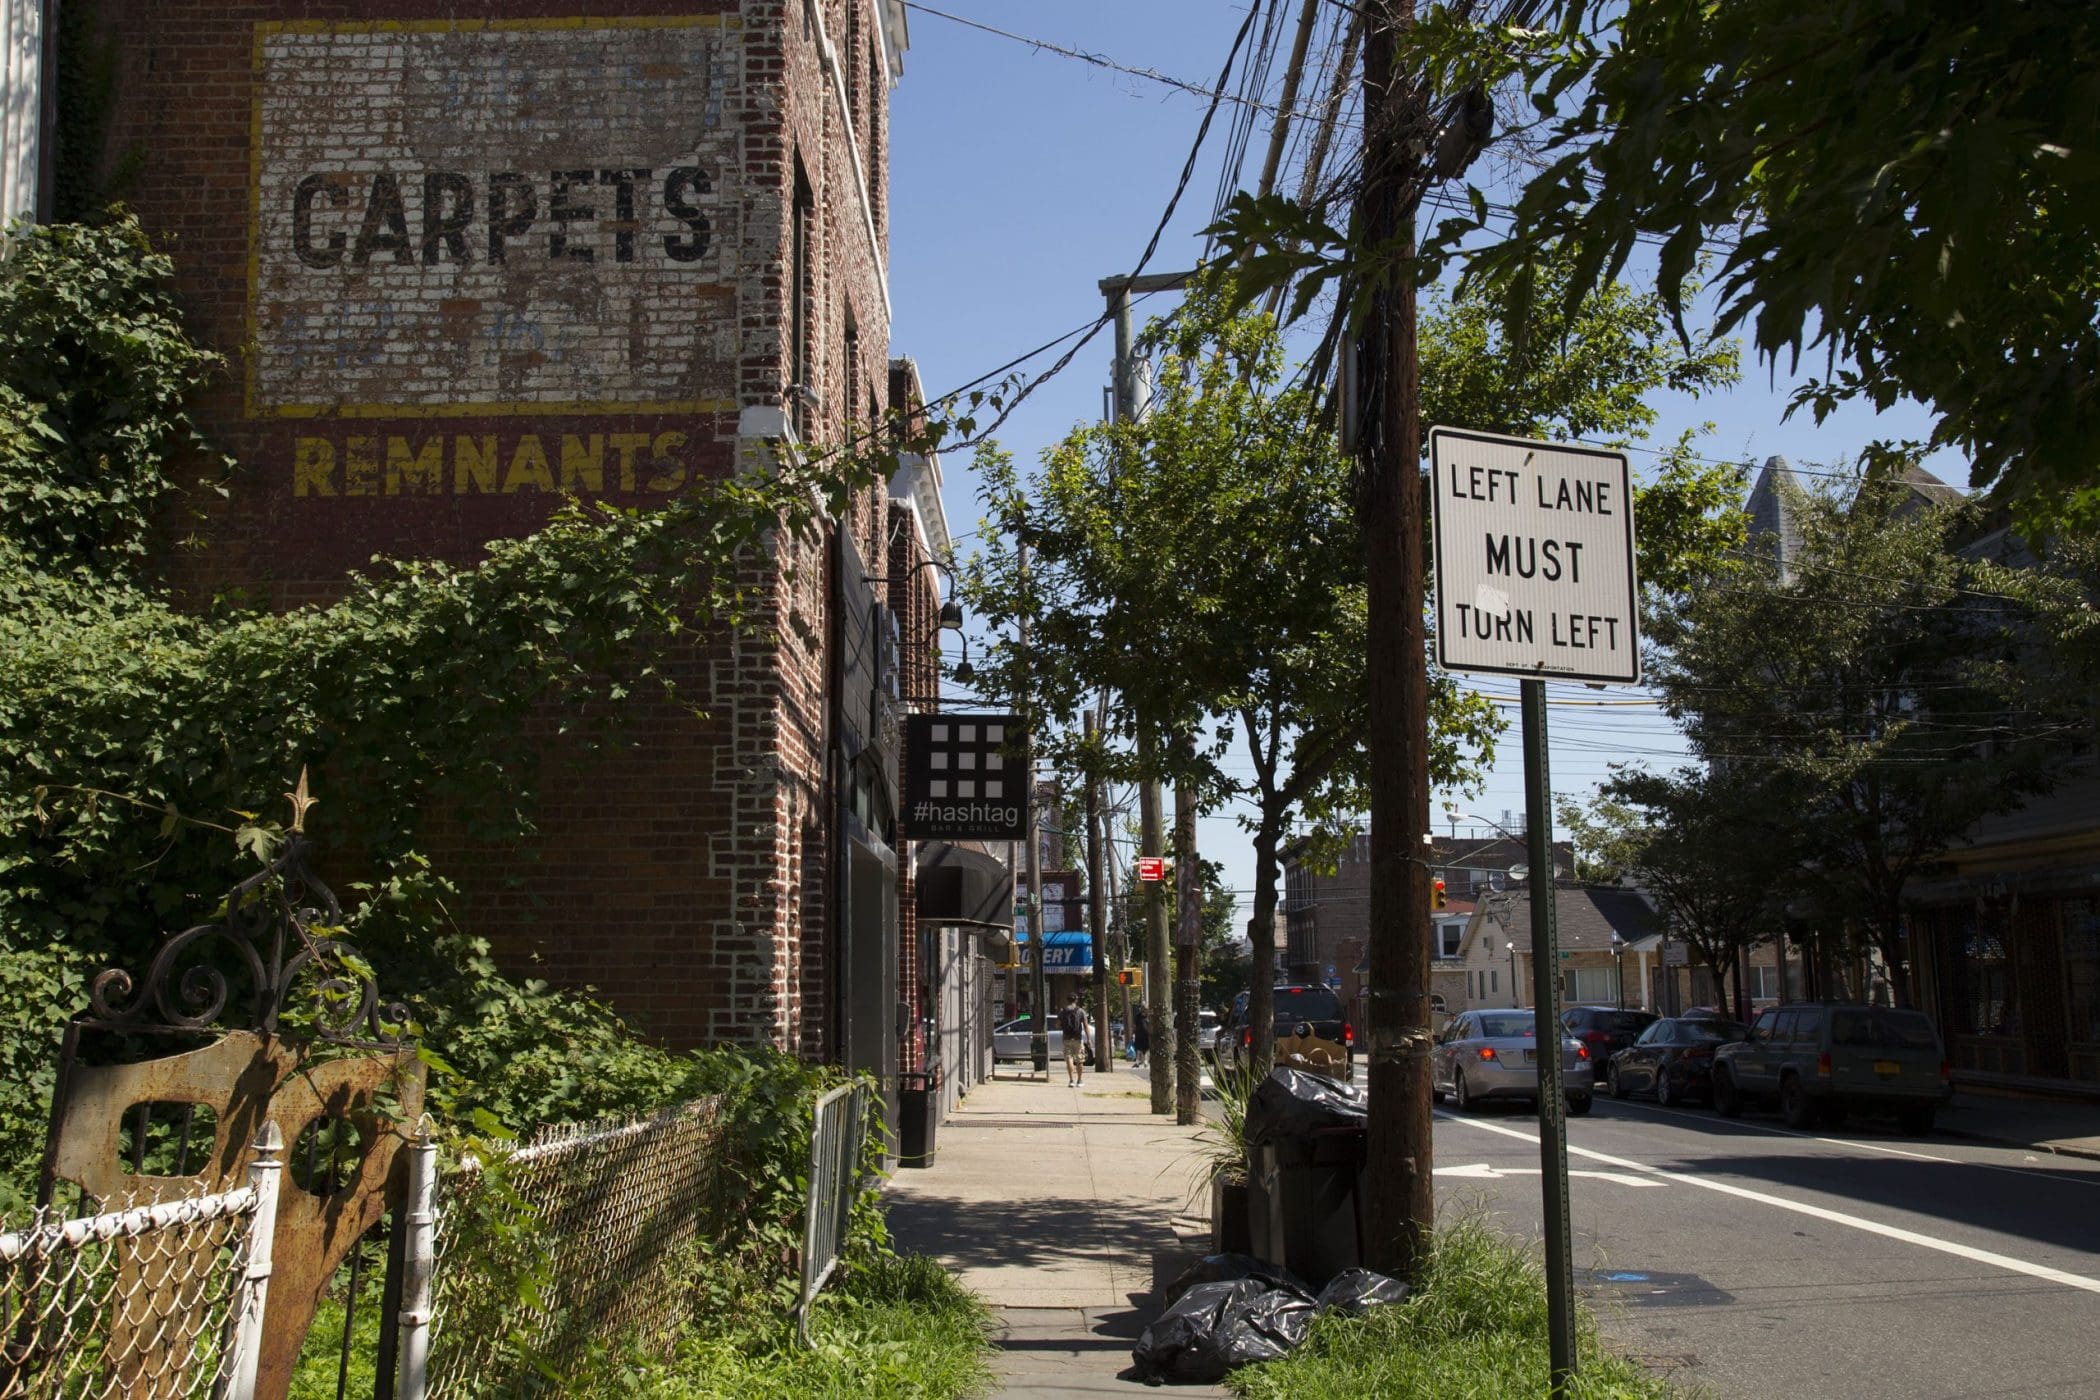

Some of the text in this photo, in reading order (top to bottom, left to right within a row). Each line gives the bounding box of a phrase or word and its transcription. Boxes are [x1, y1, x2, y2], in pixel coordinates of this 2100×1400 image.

[292, 165, 712, 270] CARPETS
[293, 431, 687, 498] REMNANTS
[1451, 463, 1612, 516] LEFT LANE
[1485, 533, 1583, 583] MUST
[1455, 603, 1619, 650] TURN LEFT
[914, 801, 1018, 827] #hashtag
[930, 824, 951, 832] BAR
[968, 824, 1000, 832] GRILL
